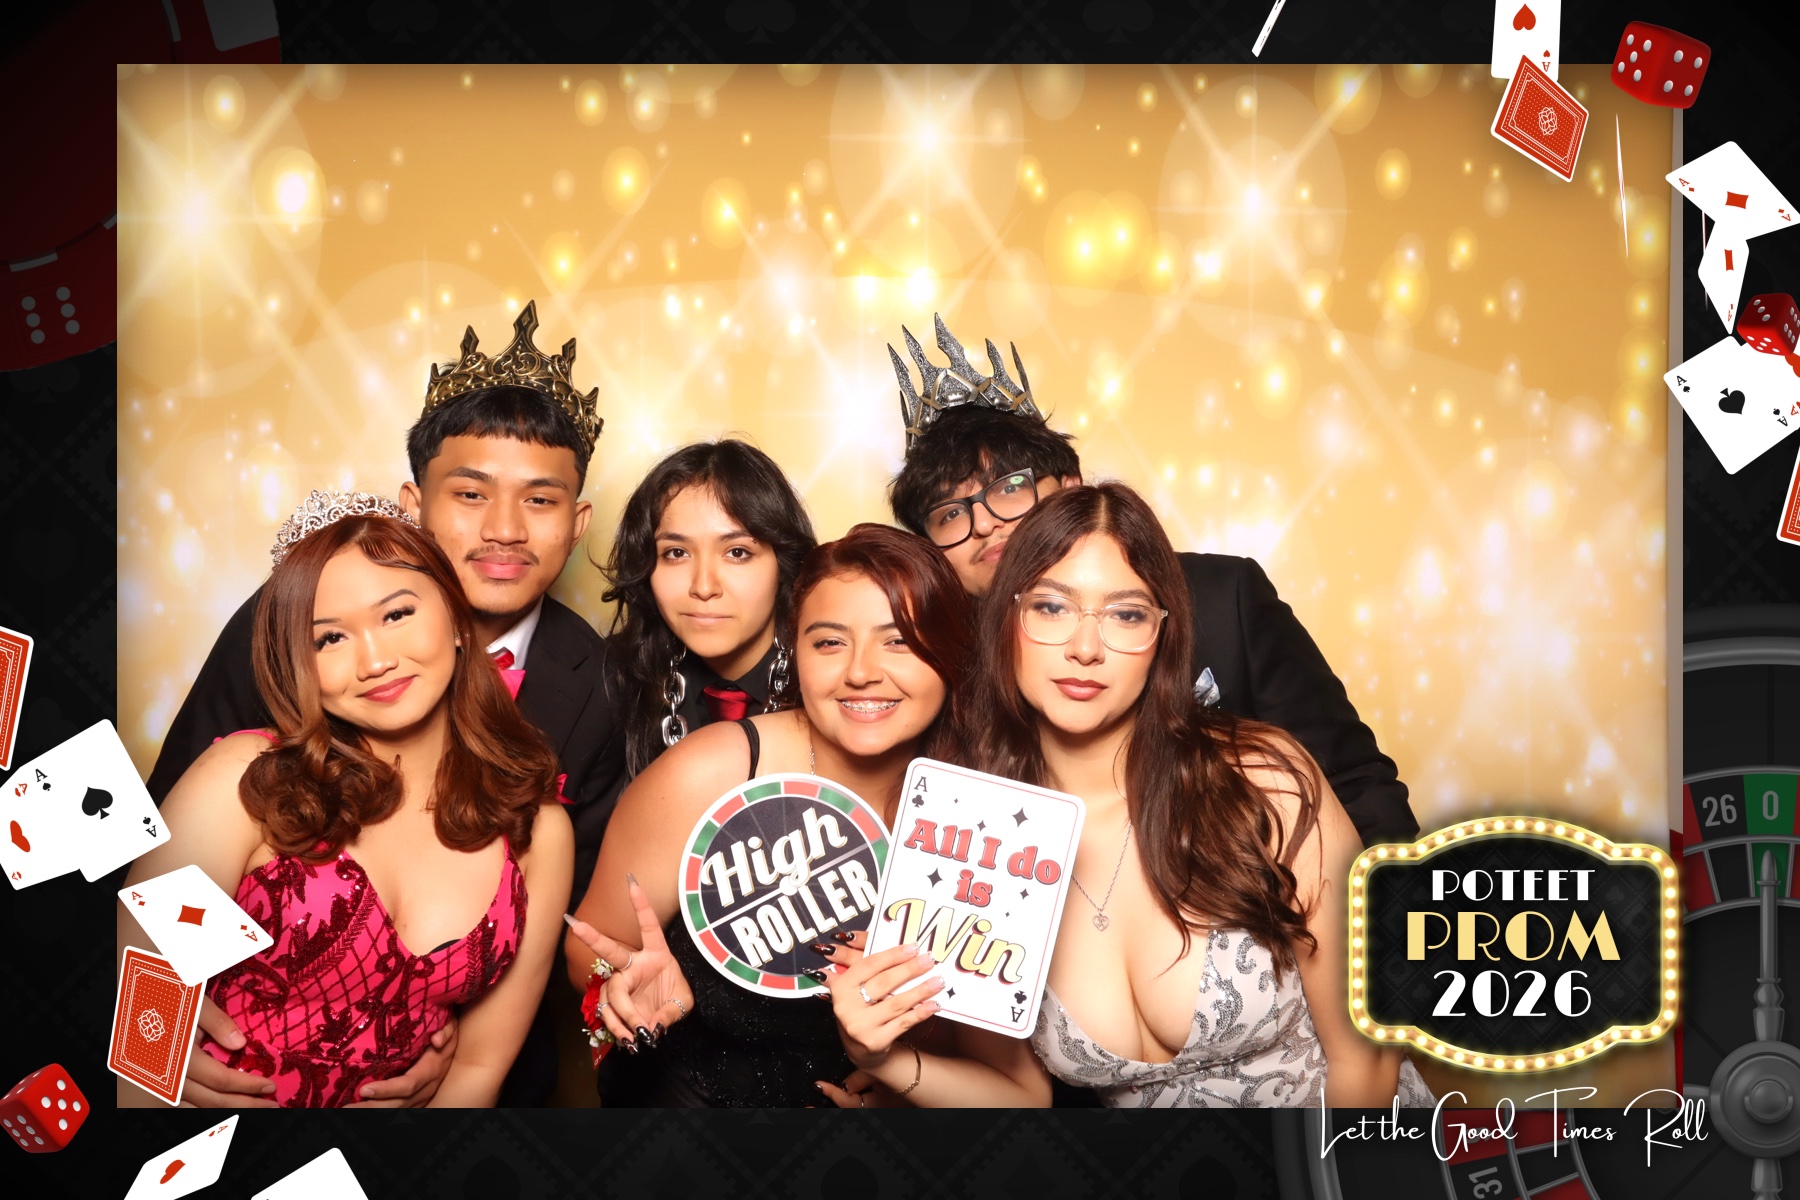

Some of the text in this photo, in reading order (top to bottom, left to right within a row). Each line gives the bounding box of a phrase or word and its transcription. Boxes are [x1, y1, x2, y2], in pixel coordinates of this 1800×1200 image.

[913, 776, 928, 792] A
[700, 807, 848, 908] High
[904, 818, 1062, 886] All I do
[730, 859, 878, 968] ROLLER
[953, 868, 994, 907] is
[883, 898, 1027, 985] Win
[1010, 1006, 1026, 1024] A
